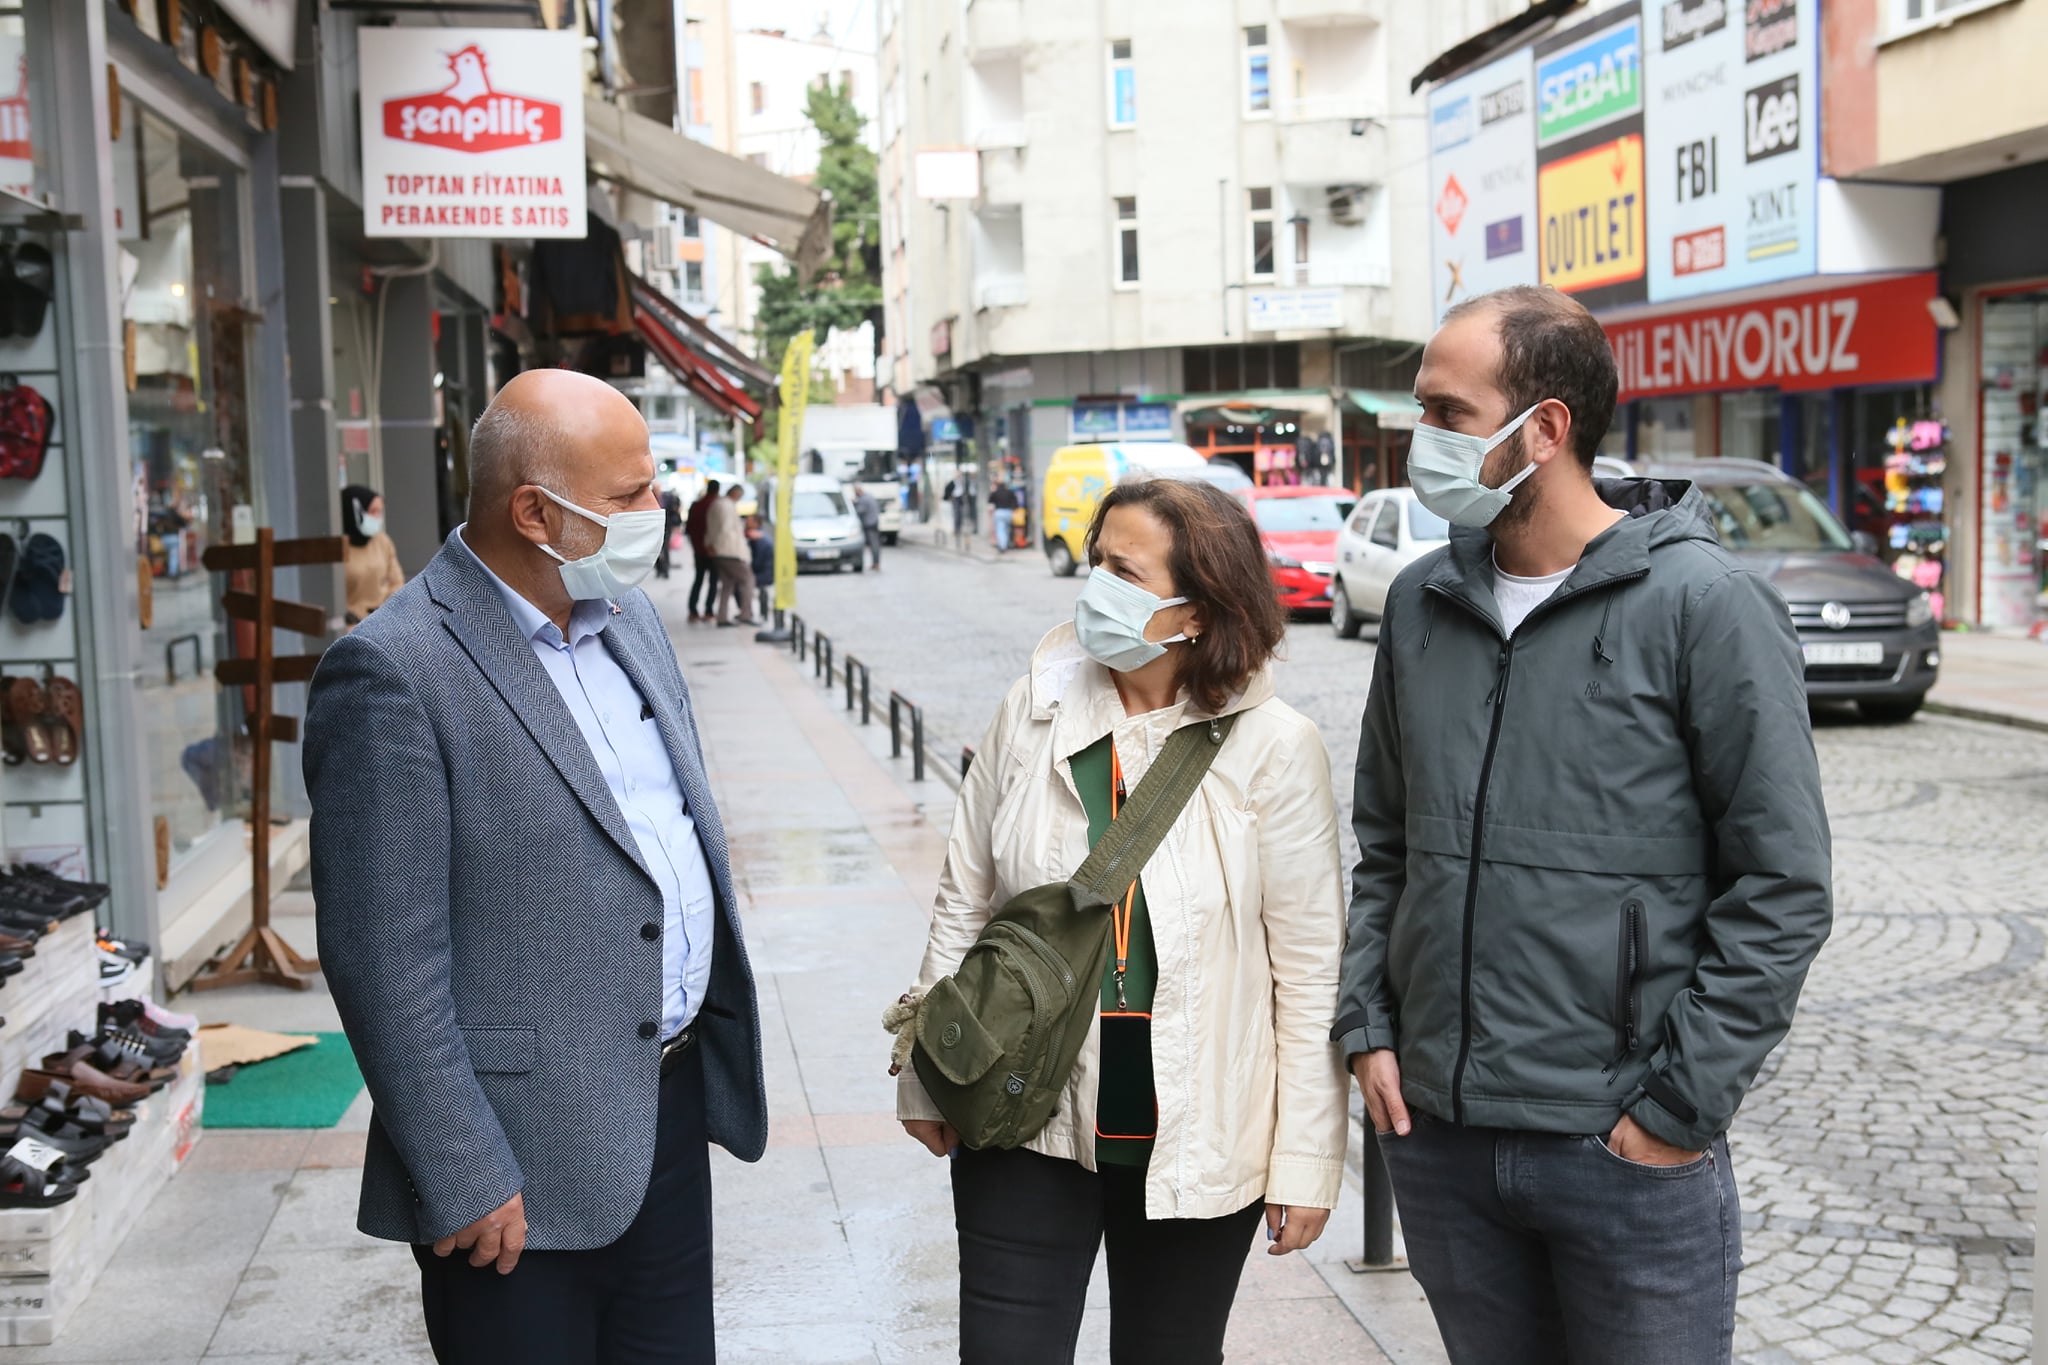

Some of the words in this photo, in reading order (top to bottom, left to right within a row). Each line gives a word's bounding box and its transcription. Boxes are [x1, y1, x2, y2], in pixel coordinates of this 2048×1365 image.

[1541, 43, 1637, 123] SEBAT
[400, 98, 544, 143] şenpiliç
[1746, 91, 1798, 156] Lee
[385, 174, 464, 195] TOPTAN
[473, 170, 564, 195] FİYATINA
[1677, 136, 1717, 203] FBI
[381, 205, 504, 226] PERAKENDE
[512, 207, 570, 228] SATIŞ
[1746, 184, 1798, 226] XINT
[1546, 193, 1635, 274] OUTLET
